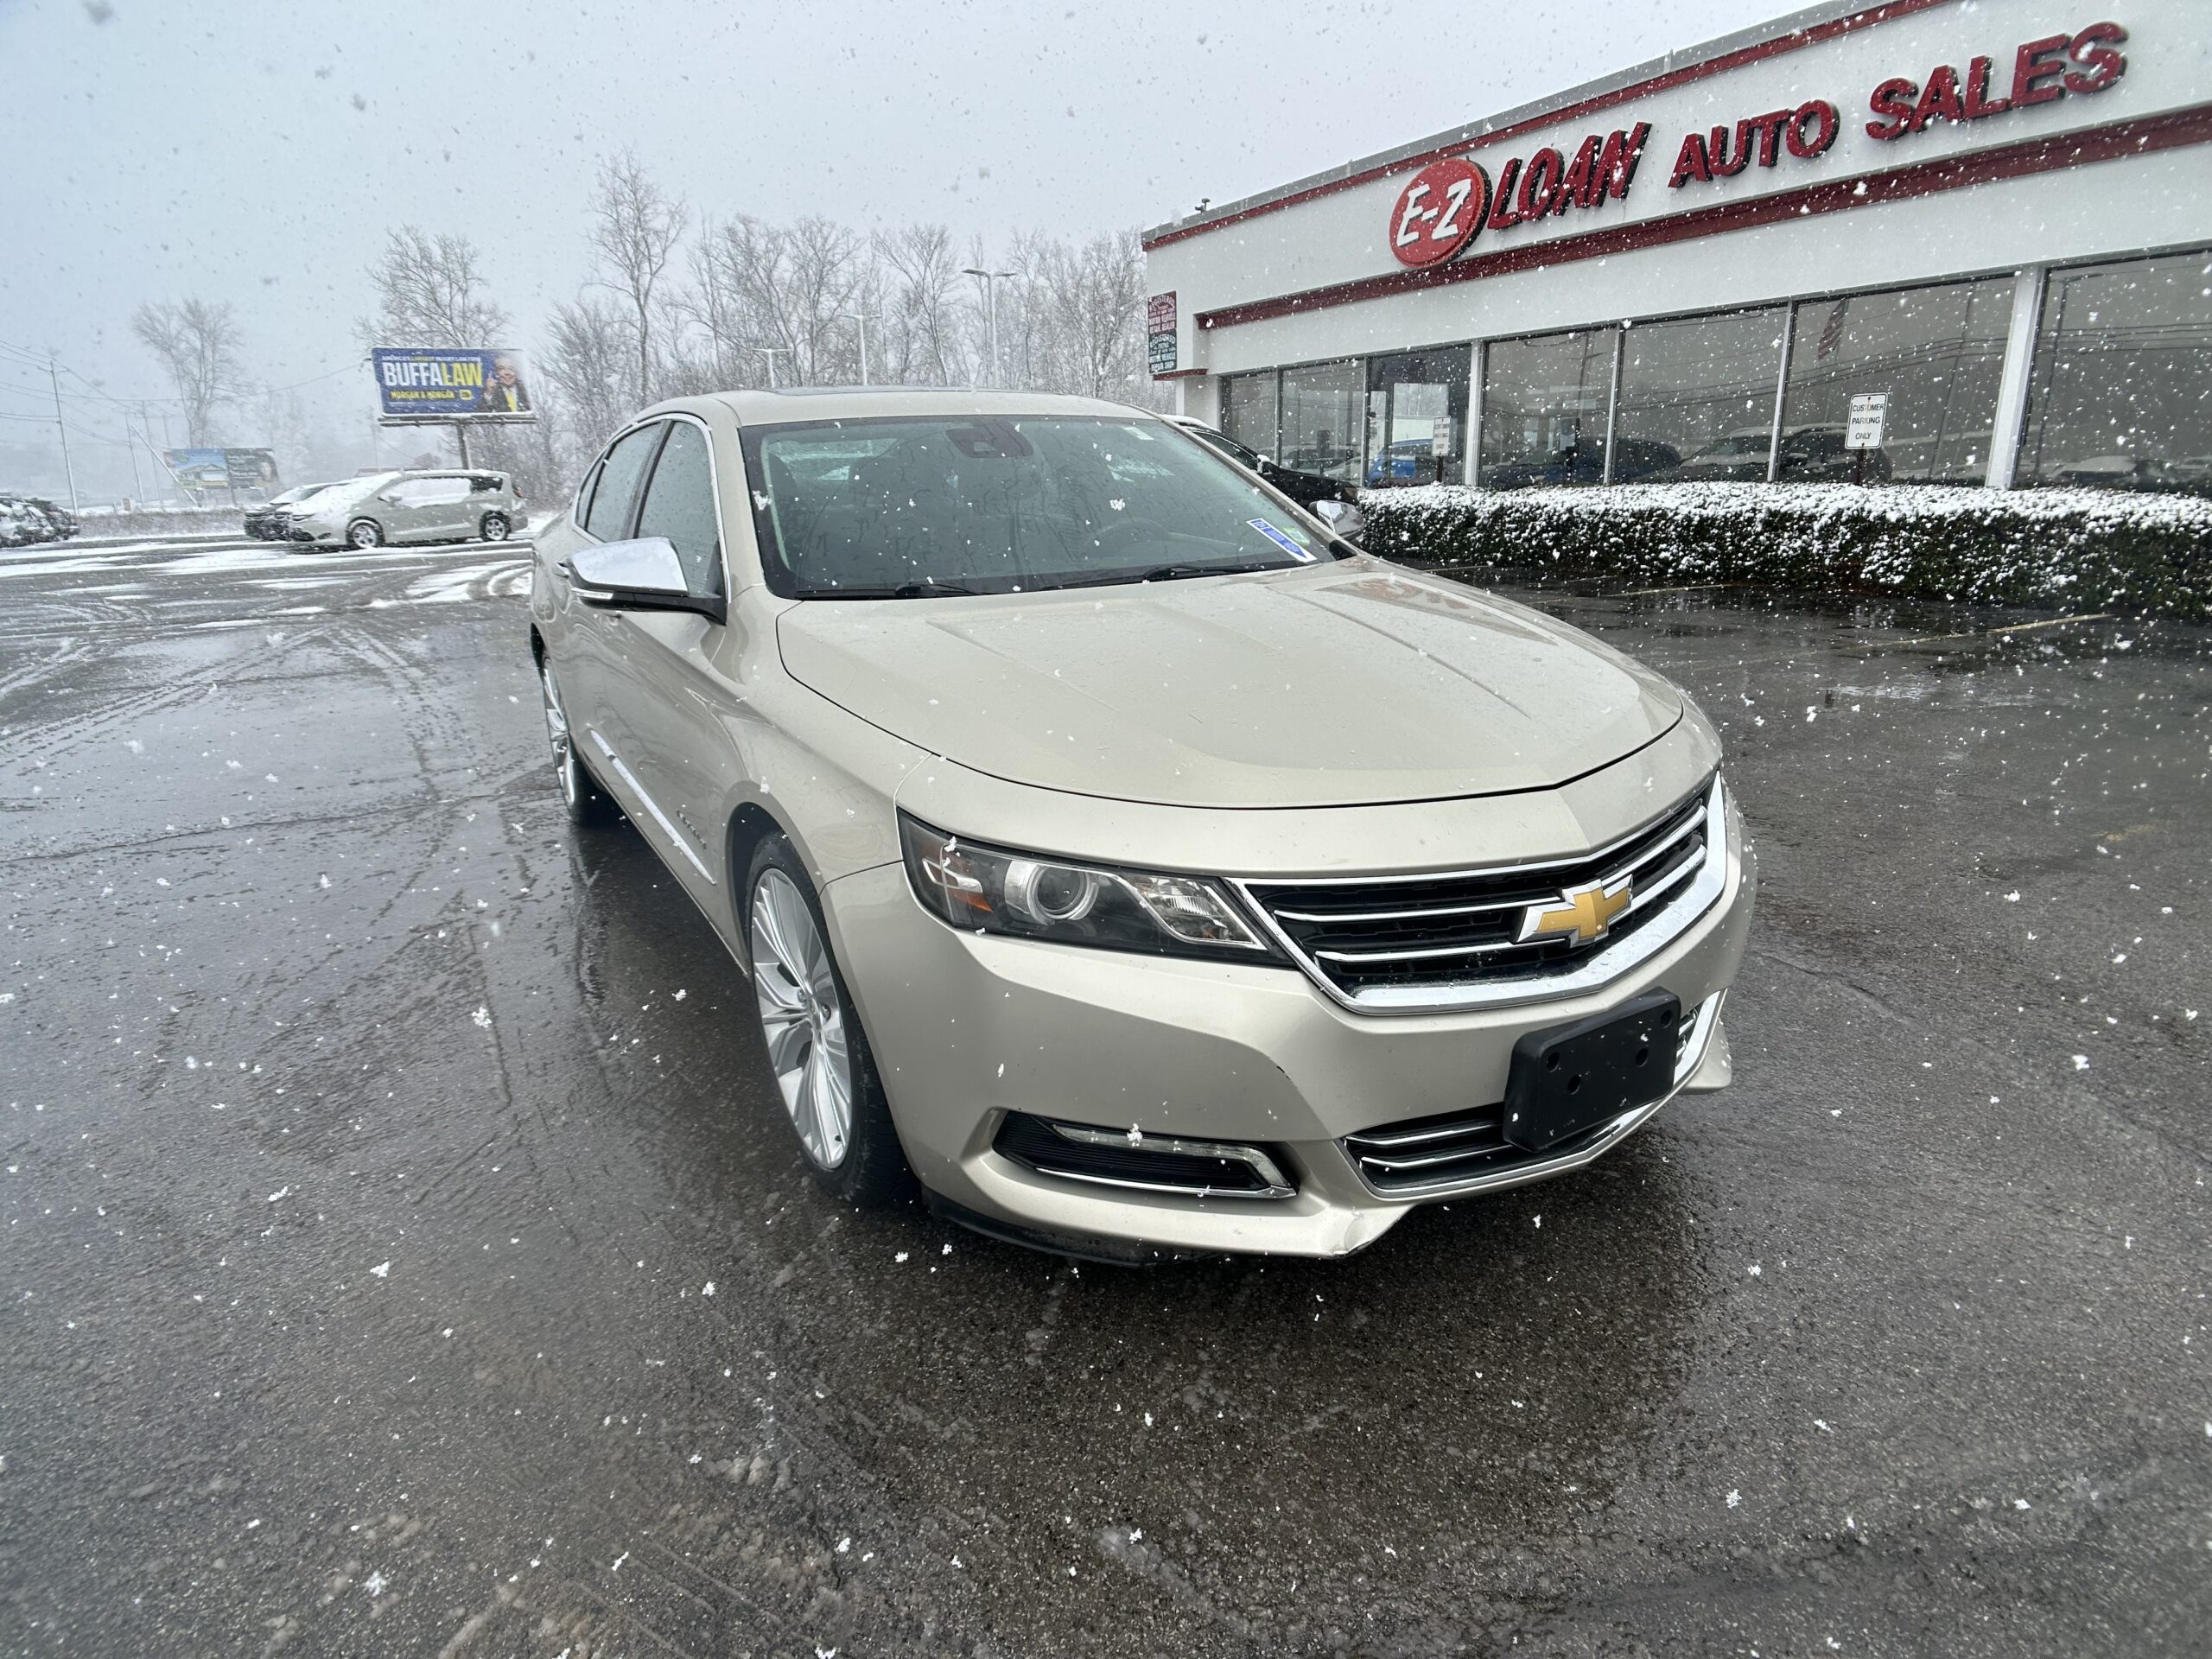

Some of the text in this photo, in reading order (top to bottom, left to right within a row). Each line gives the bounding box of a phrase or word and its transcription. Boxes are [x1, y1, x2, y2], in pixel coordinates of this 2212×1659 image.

[1396, 21, 2129, 247] E-Z LOAN AUTO SALES
[382, 361, 483, 387] BUFFALAW
[1853, 404, 1884, 412] CUSTOMER
